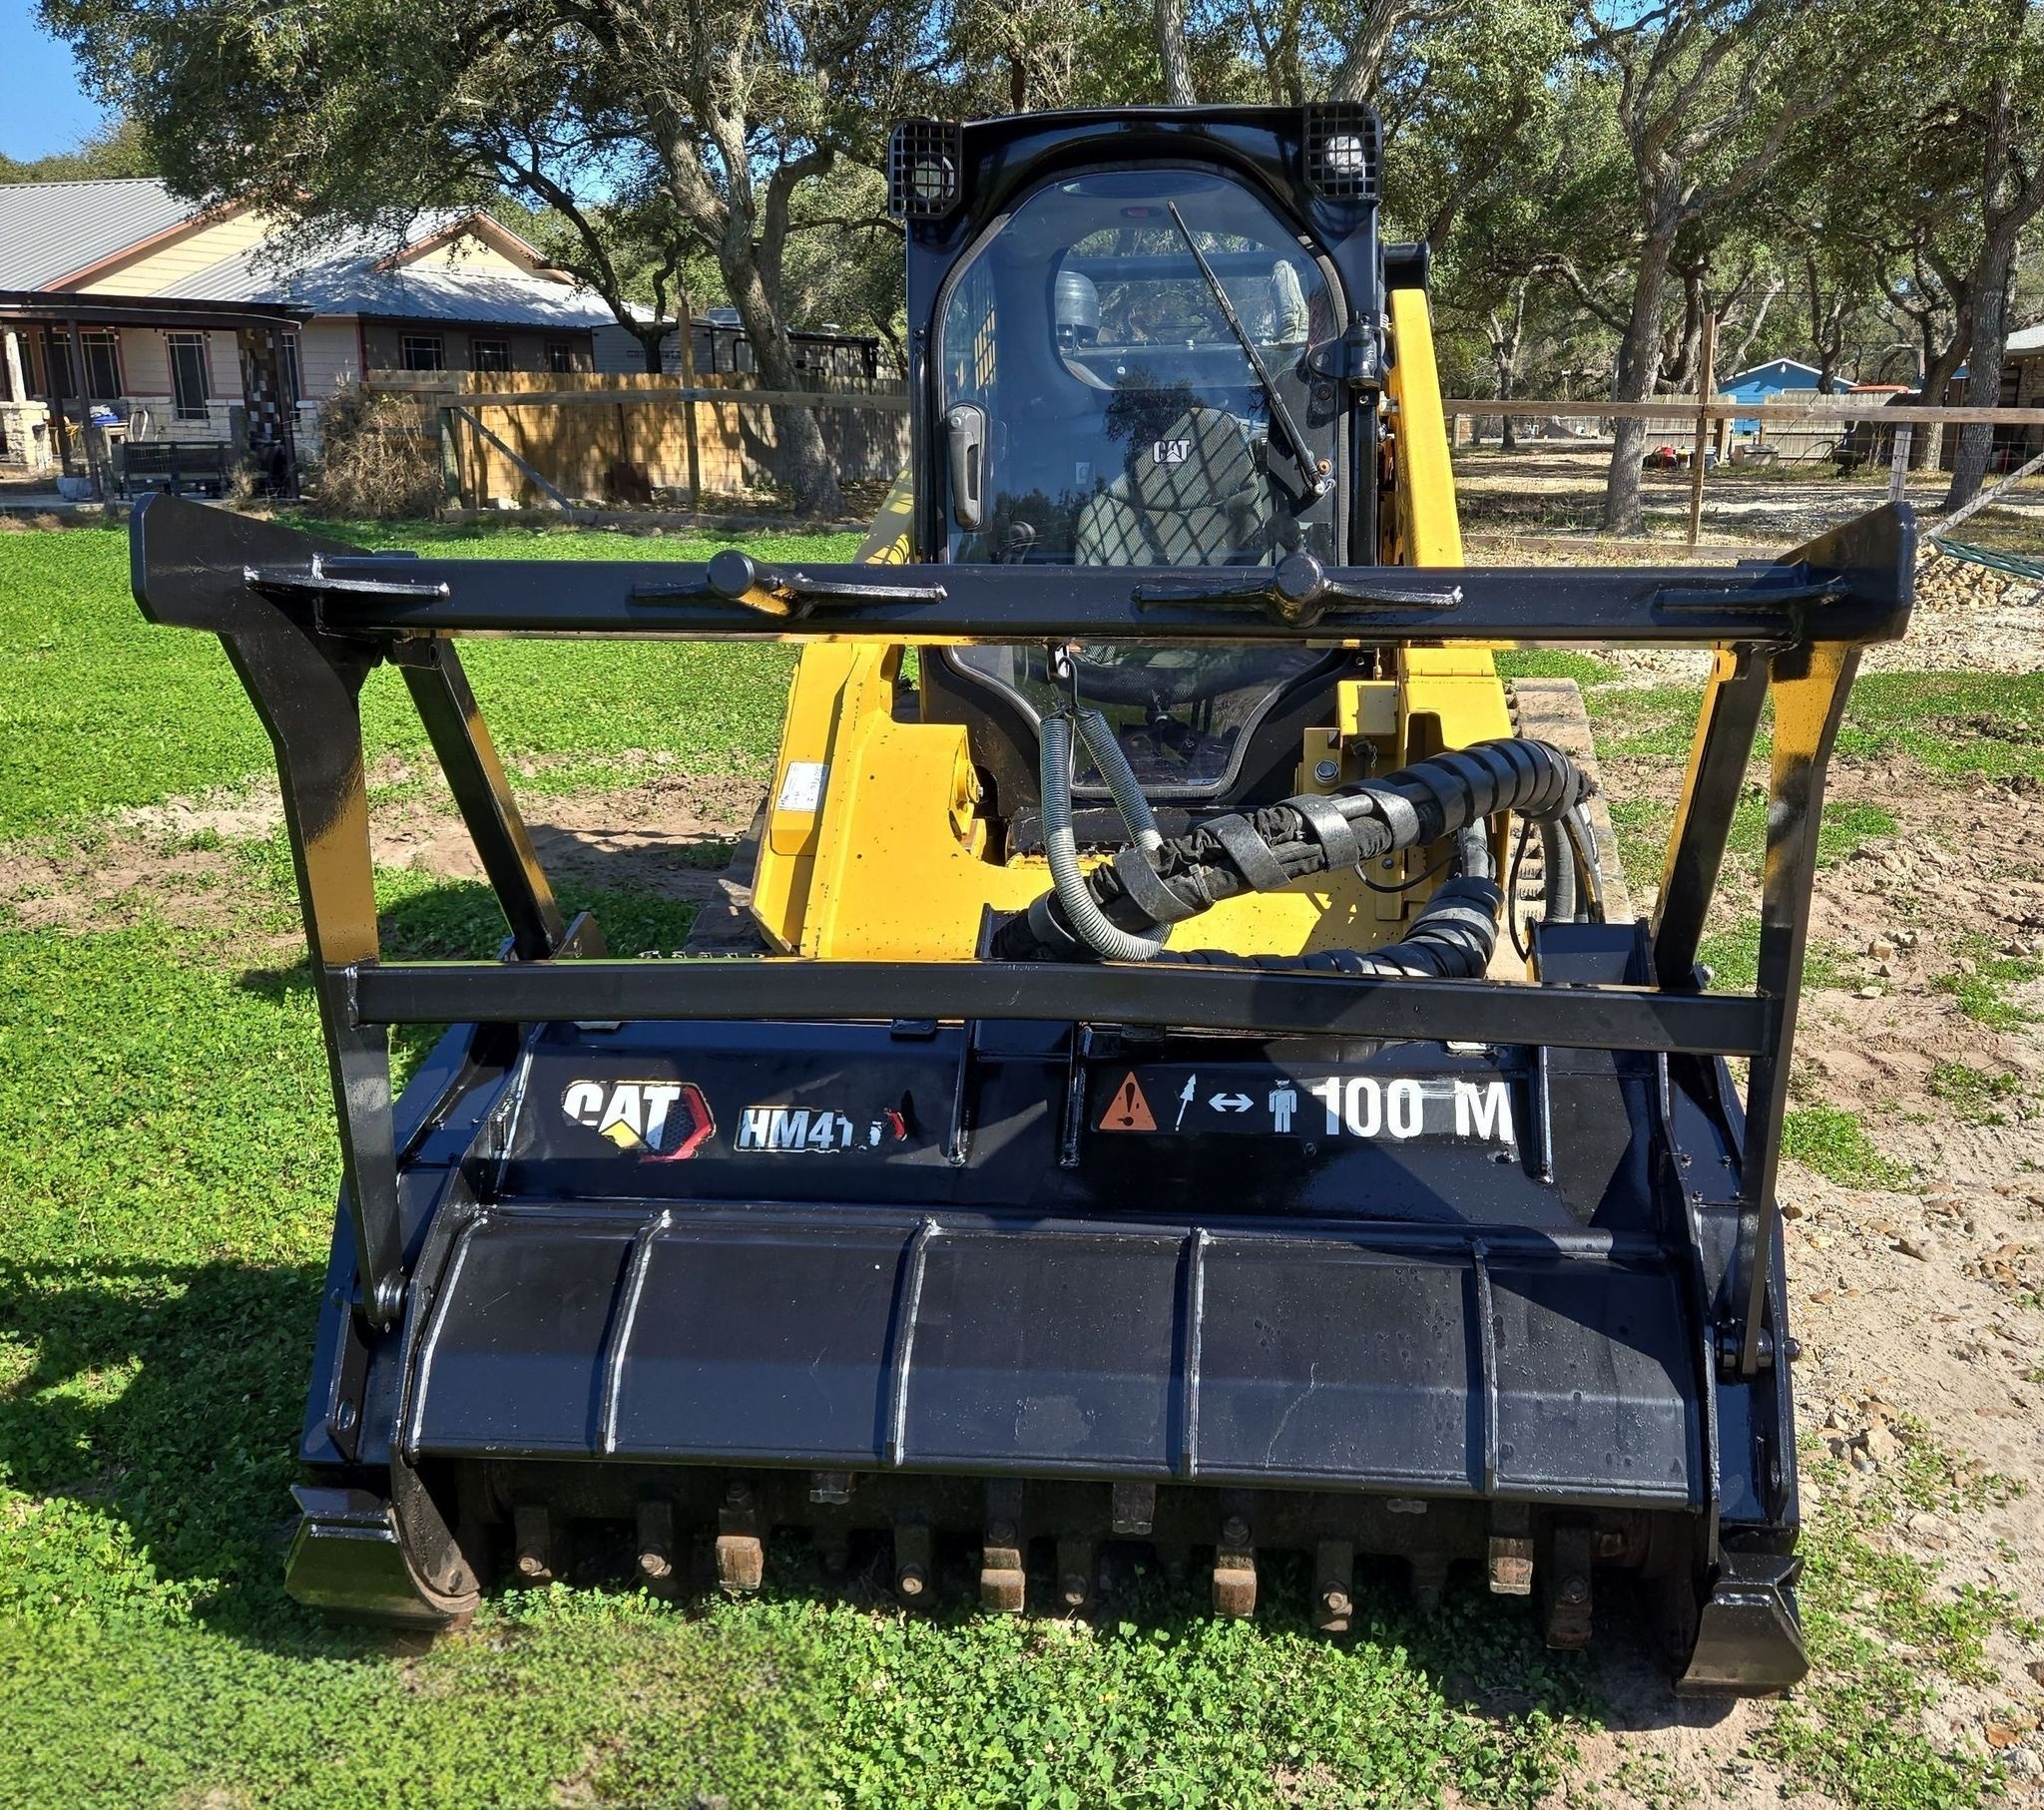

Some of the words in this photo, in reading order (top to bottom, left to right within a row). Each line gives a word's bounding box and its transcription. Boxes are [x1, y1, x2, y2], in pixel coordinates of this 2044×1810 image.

[1153, 440, 1191, 463] CAT
[564, 1083, 681, 1150] CAT
[1311, 1077, 1423, 1138] 100
[1454, 1079, 1515, 1145] M
